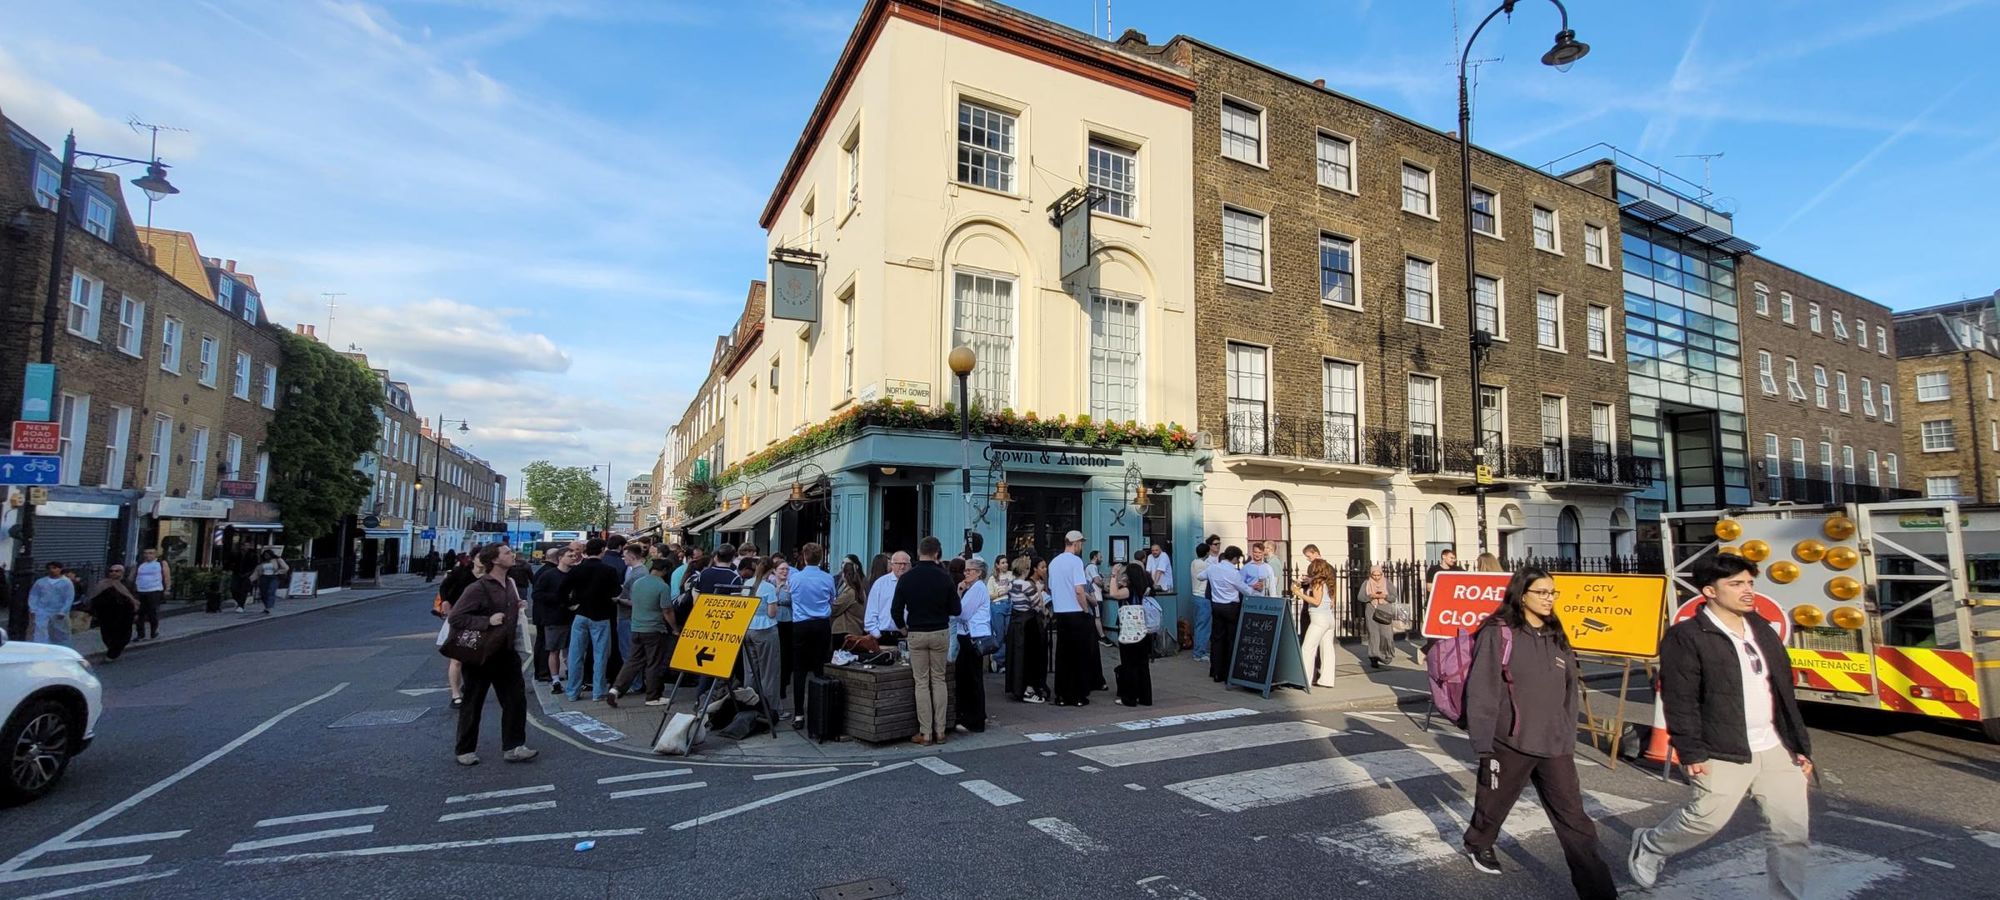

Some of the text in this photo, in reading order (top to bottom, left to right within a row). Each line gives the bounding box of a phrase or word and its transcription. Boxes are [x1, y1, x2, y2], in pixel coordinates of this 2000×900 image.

[886, 386, 907, 396] NORTH
[908, 388, 929, 397] GOWER
[983, 446, 1111, 467] Crown & Anchor
[1453, 584, 1507, 602] ROAD
[1583, 584, 1614, 593] CCTV
[704, 598, 749, 609] PEDESTRIAN
[1592, 595, 1605, 603] IN
[705, 610, 736, 620] ACCESS
[1563, 604, 1633, 616] OPERATION
[710, 620, 720, 629] TO
[682, 628, 743, 644] EUSTON STATION
[1791, 658, 1866, 672] MAINTENANCE
